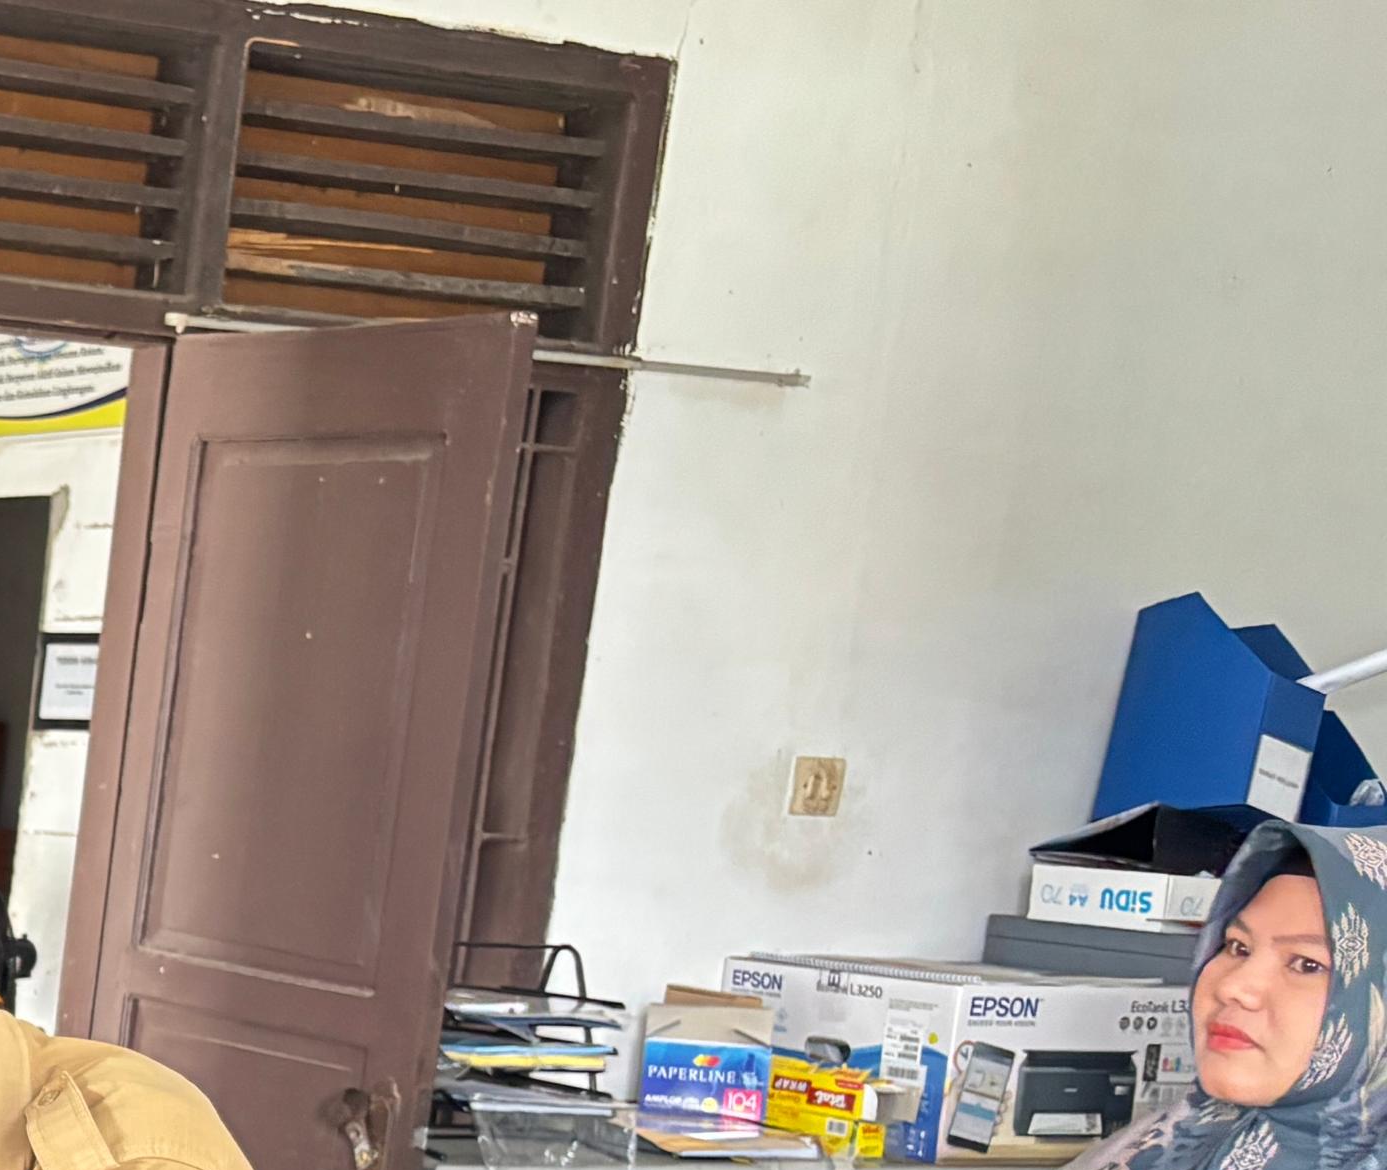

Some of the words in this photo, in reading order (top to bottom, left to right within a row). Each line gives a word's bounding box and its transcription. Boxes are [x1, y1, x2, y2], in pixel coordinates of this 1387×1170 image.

[732, 969, 783, 990] EPSON
[850, 982, 883, 998] L3250
[970, 996, 1039, 1017] EPSON
[647, 1064, 736, 1084] PAPERLINE
[774, 1078, 808, 1093] WRAP
[728, 1091, 757, 1112] 104
